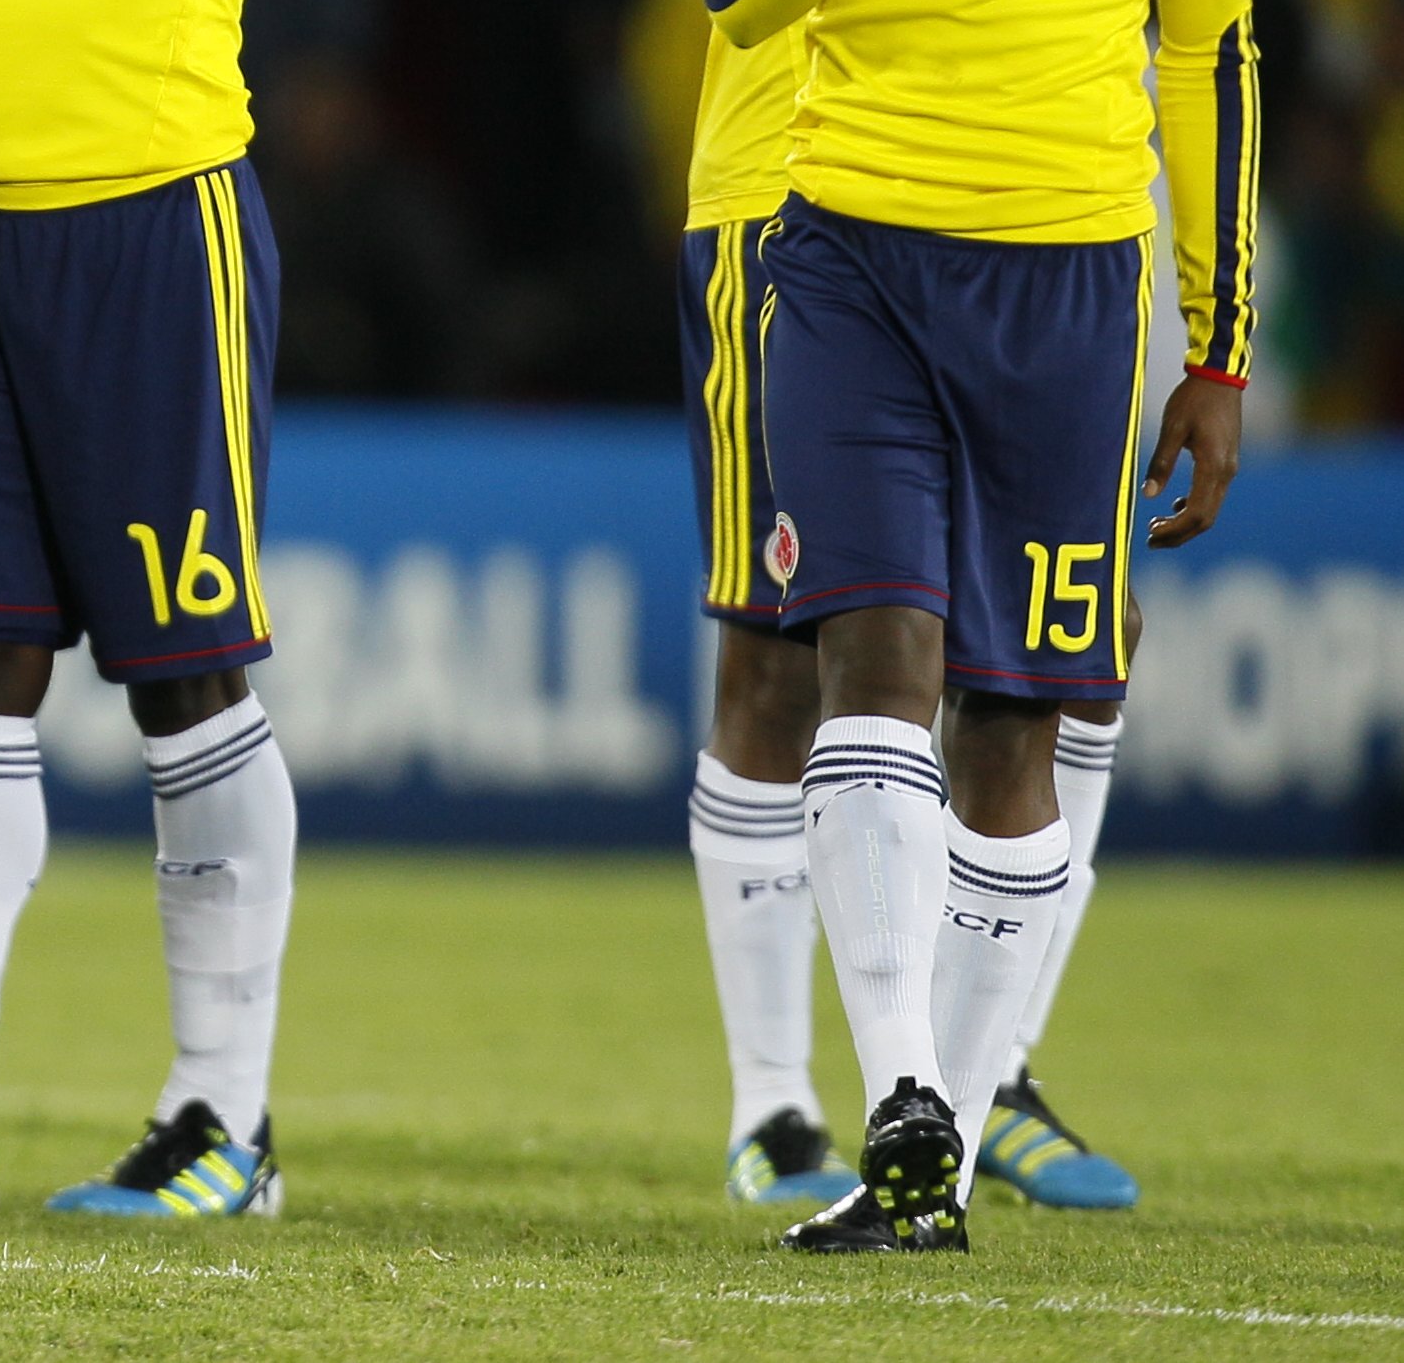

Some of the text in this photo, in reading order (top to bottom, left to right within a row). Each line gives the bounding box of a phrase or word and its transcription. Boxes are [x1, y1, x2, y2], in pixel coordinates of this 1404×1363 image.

[126, 508, 237, 626] 16
[1024, 542, 1107, 654] 15
[155, 858, 227, 876] CF
